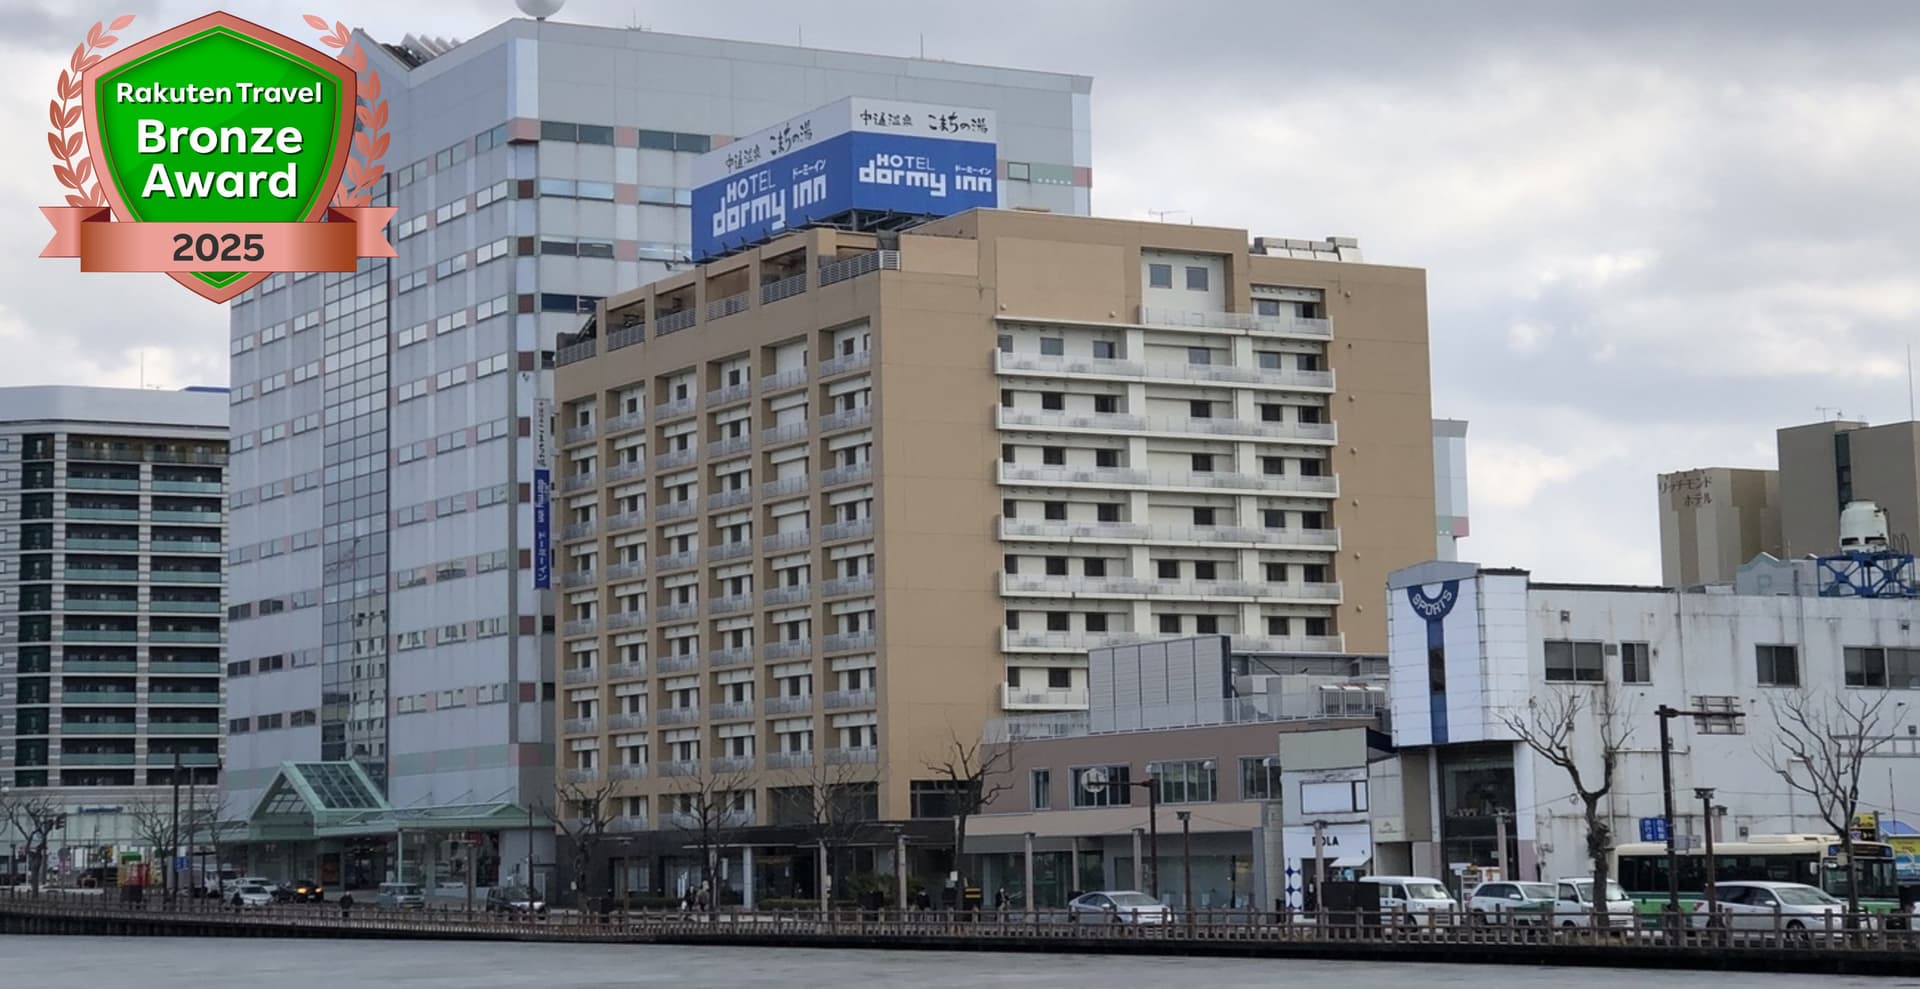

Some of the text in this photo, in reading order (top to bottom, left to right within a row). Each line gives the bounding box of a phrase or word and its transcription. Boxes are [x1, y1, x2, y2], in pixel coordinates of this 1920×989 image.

[927, 111, 989, 134] こまちの湯
[769, 119, 813, 156] こまちの湯
[792, 159, 827, 181] ドーミーイン
[876, 153, 936, 171] HOTEL
[954, 164, 992, 176] ドーミーイン
[726, 168, 777, 204] HOTEL
[858, 159, 993, 198] dormy inn
[712, 173, 827, 238] dormy inn
[1412, 589, 1453, 616] SPORTS
